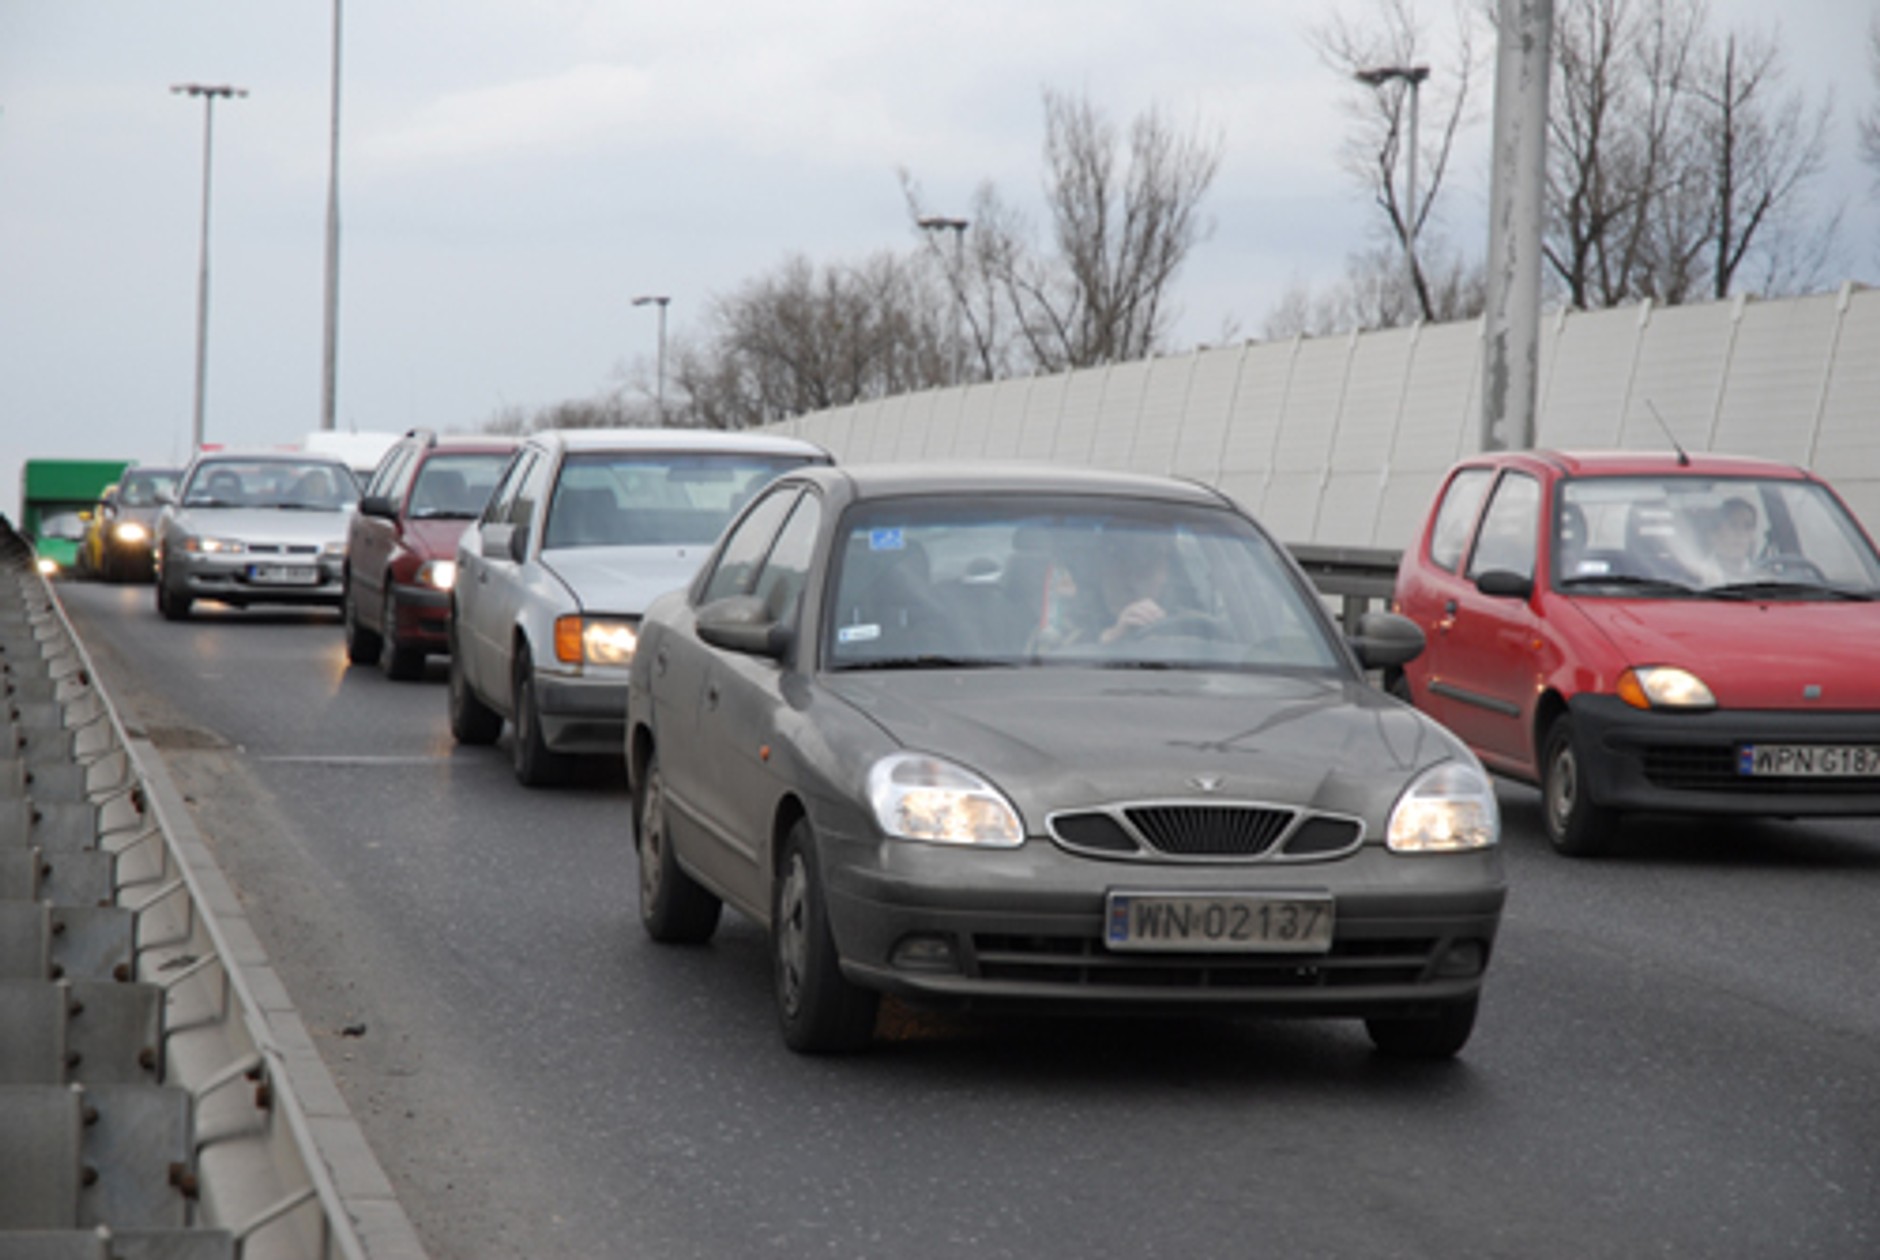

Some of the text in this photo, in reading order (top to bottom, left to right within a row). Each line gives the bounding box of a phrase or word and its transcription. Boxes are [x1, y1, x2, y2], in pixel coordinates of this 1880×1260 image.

[1756, 748, 1814, 773] WPN
[1135, 902, 1325, 942] WN 02137
